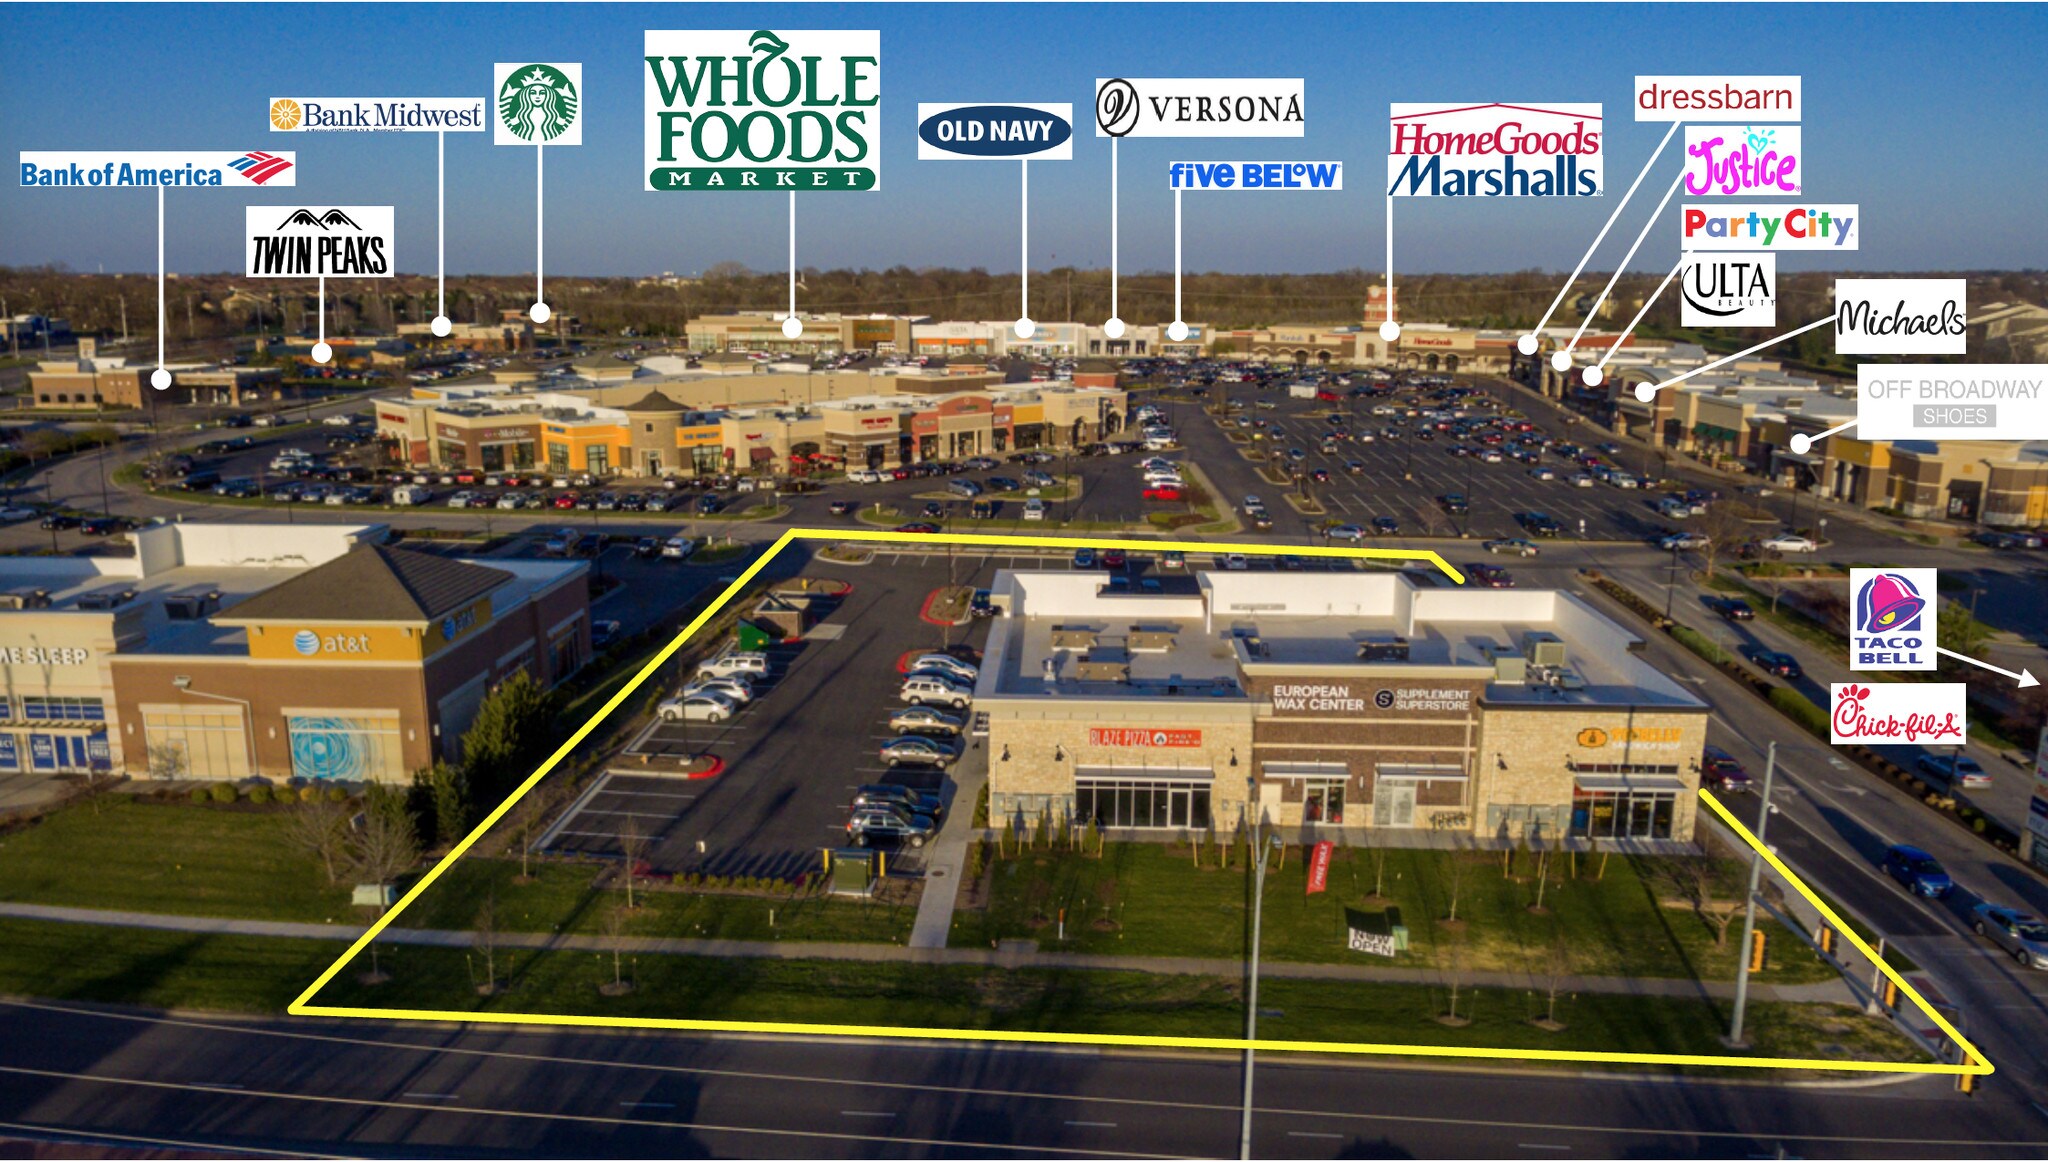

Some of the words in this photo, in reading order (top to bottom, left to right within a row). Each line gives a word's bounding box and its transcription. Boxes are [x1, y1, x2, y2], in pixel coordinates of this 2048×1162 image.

[324, 633, 370, 653] at&t
[27, 647, 88, 665] SLEEP
[1274, 685, 1349, 698] EUROPEAN
[1396, 689, 1471, 700] SUPPLEMENT
[1274, 698, 1306, 711] WAX
[1309, 699, 1364, 711] CENTER
[1396, 700, 1470, 711] SUPERSTORE
[1125, 730, 1151, 747] PIZZA
[1353, 929, 1390, 944] NOW
[1352, 940, 1392, 954] OPEN
